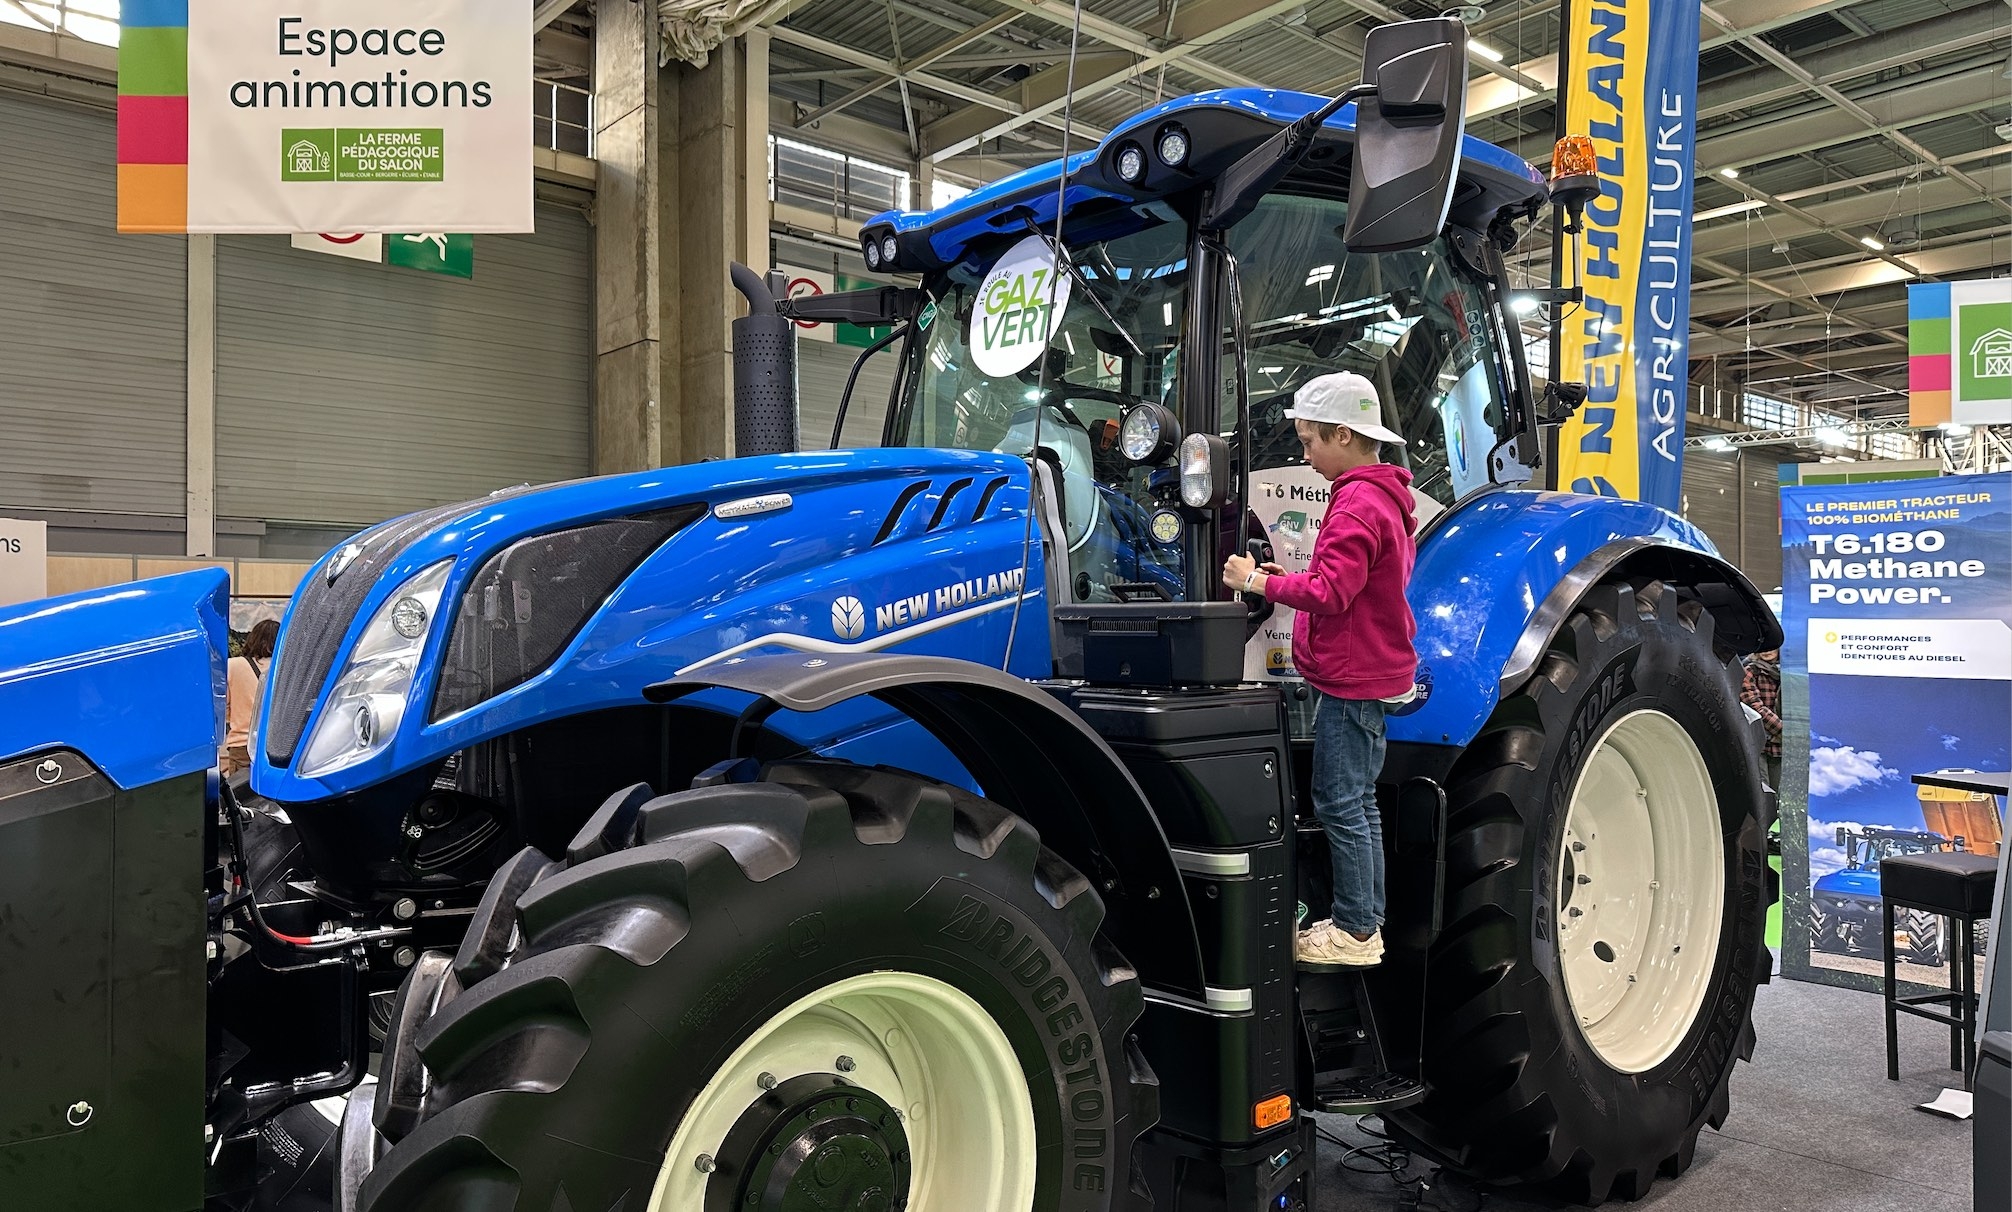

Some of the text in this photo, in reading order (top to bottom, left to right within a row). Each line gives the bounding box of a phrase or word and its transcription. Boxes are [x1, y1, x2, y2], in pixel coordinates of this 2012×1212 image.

[278, 17, 445, 67] Espace
[229, 69, 492, 108] animations
[360, 133, 422, 145] LA FERME
[341, 143, 439, 159] PÉDAGOGIQUE
[358, 159, 423, 170] DU SALON
[1579, 0, 1626, 455] NEW HOLLAN
[1648, 88, 1683, 462] AGRICULTURE
[985, 268, 1049, 315] GAZ
[983, 302, 1057, 351] VERT
[1290, 485, 1331, 503] Méth
[1806, 493, 1991, 513] LE PREMIER TRACTEUR
[1807, 509, 1960, 525] 100% BIOMÉTHANE
[1808, 530, 1945, 554] T6.180
[1809, 558, 1986, 579] Methane
[1809, 584, 1952, 605] Power.
[875, 592, 929, 632] NEW
[1265, 629, 1293, 640] Vene
[1841, 653, 1906, 661] IDENTIQUES
[938, 894, 1106, 1193] BRIDGESTONE
